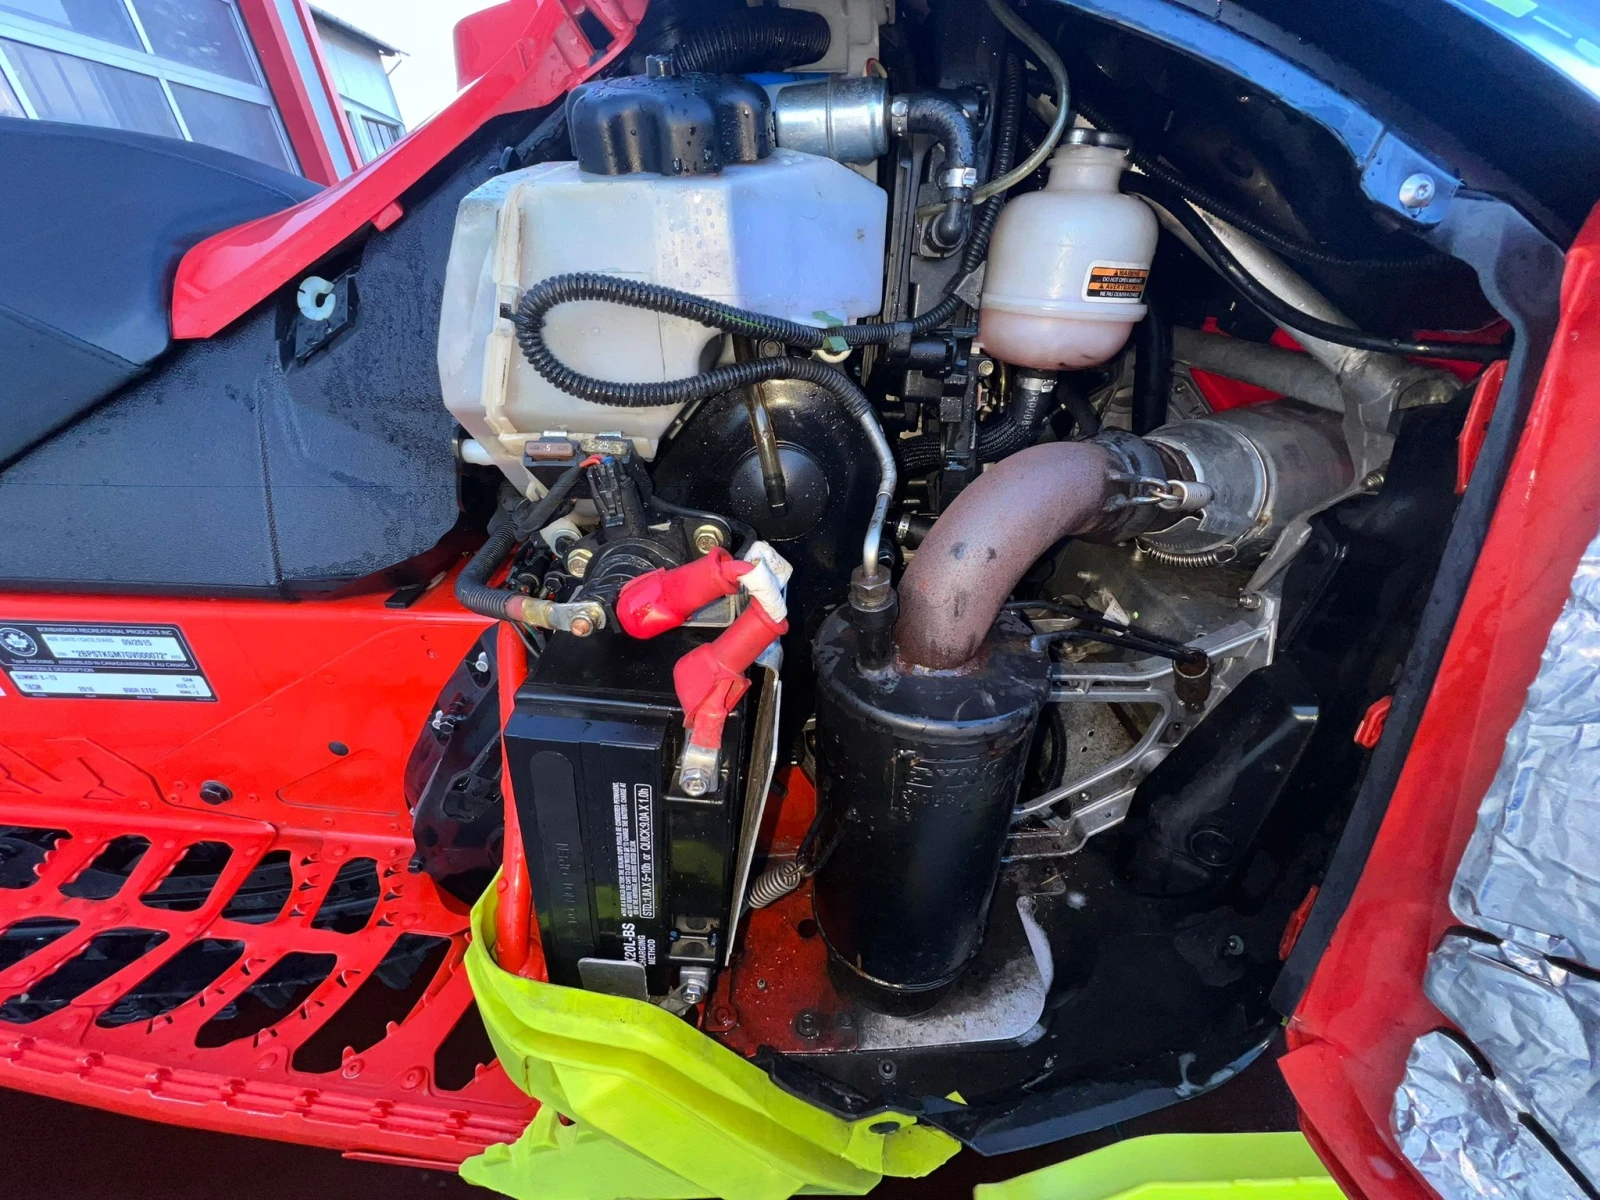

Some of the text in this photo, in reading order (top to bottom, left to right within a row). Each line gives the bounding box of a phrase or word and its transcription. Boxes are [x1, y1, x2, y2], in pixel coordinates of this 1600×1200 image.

[638, 788, 649, 803] 1.0h
[642, 853, 651, 861] or
[647, 939, 656, 965] METHOD
